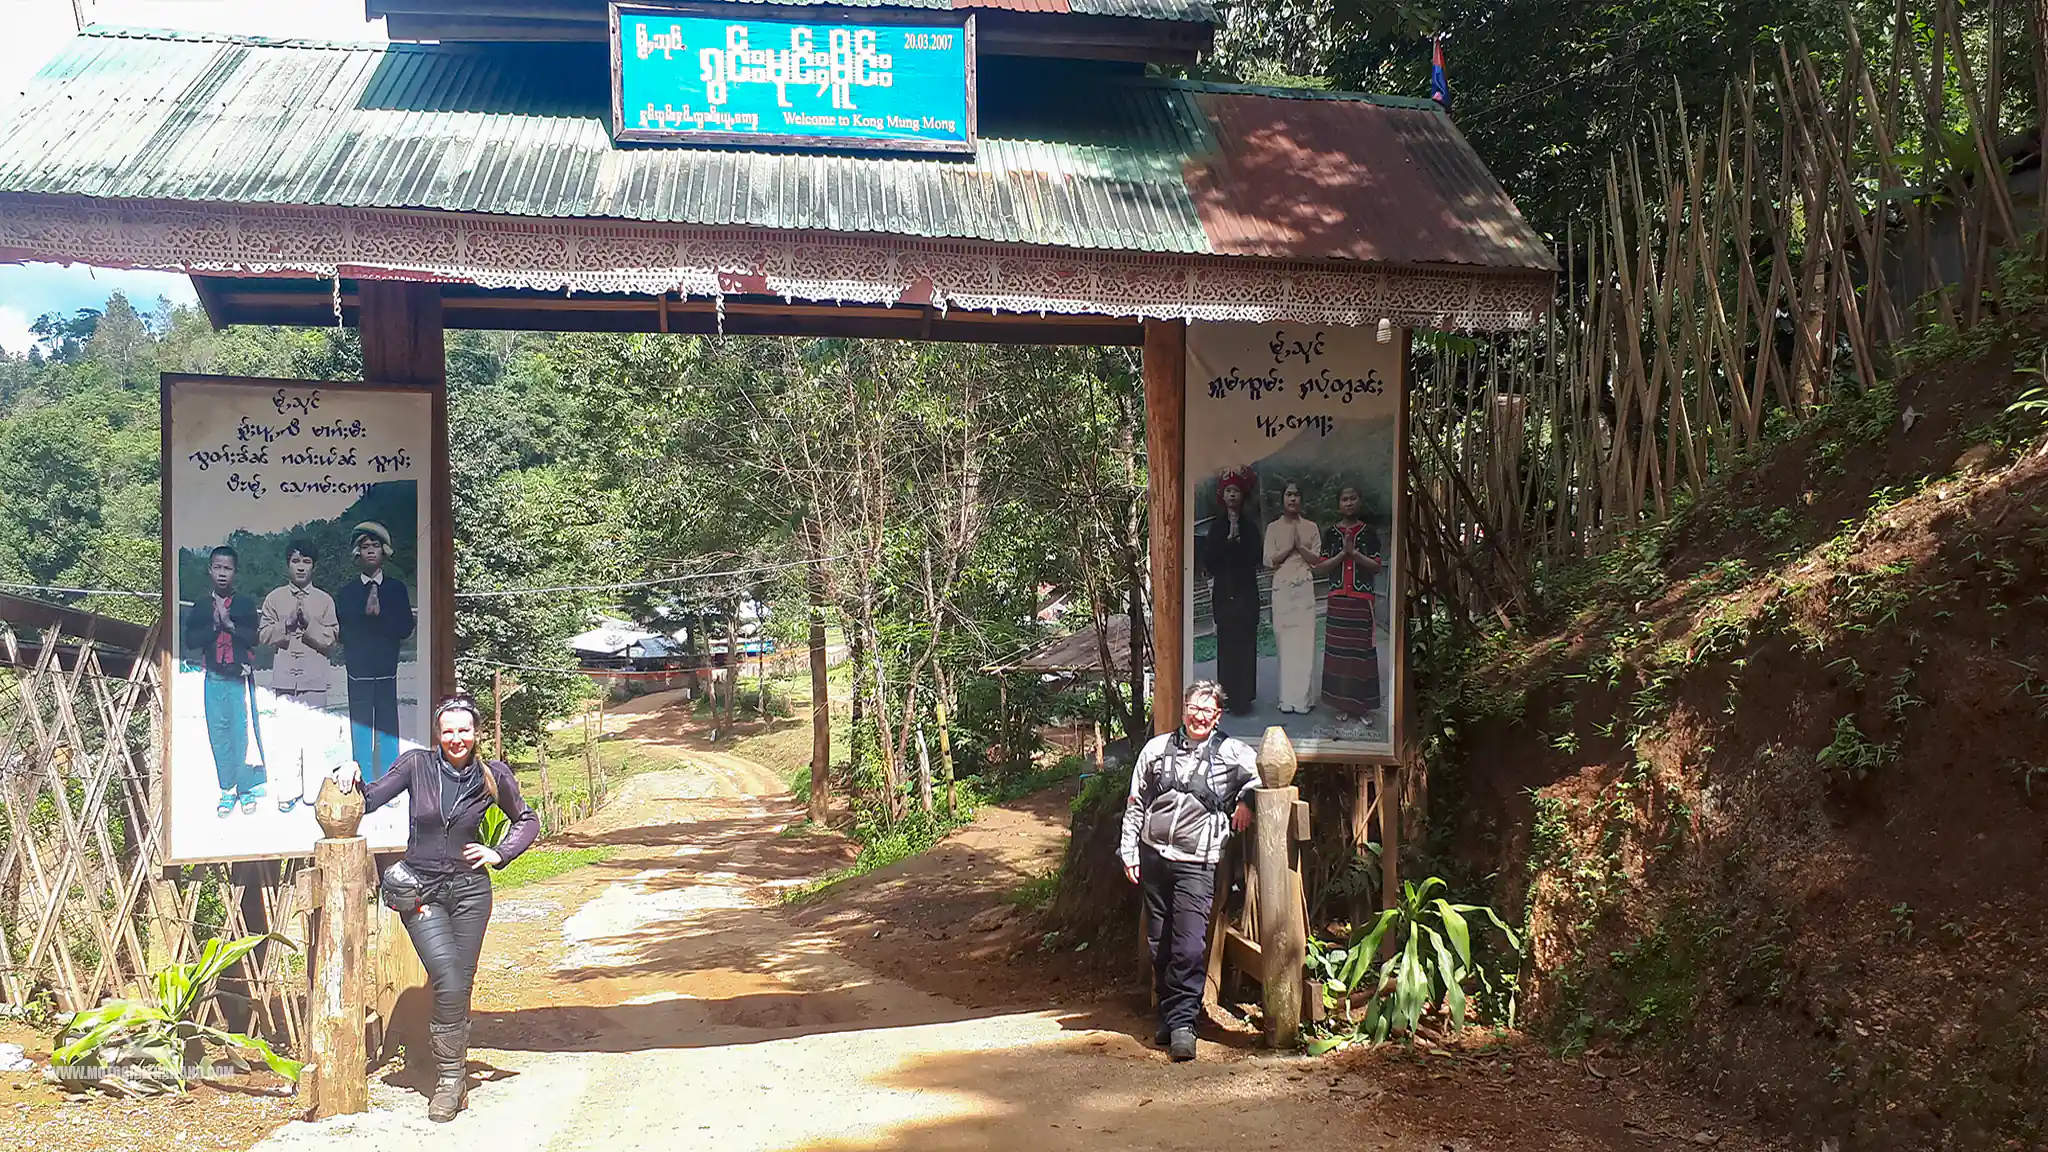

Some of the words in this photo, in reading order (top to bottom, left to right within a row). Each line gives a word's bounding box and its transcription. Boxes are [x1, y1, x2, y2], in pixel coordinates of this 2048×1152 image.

[905, 33, 952, 50] 20.03.2007
[783, 112, 836, 126] Welcome
[838, 115, 850, 126] to
[851, 114, 885, 131] Kong
[886, 116, 921, 132] Mung
[923, 116, 955, 132] Mong
